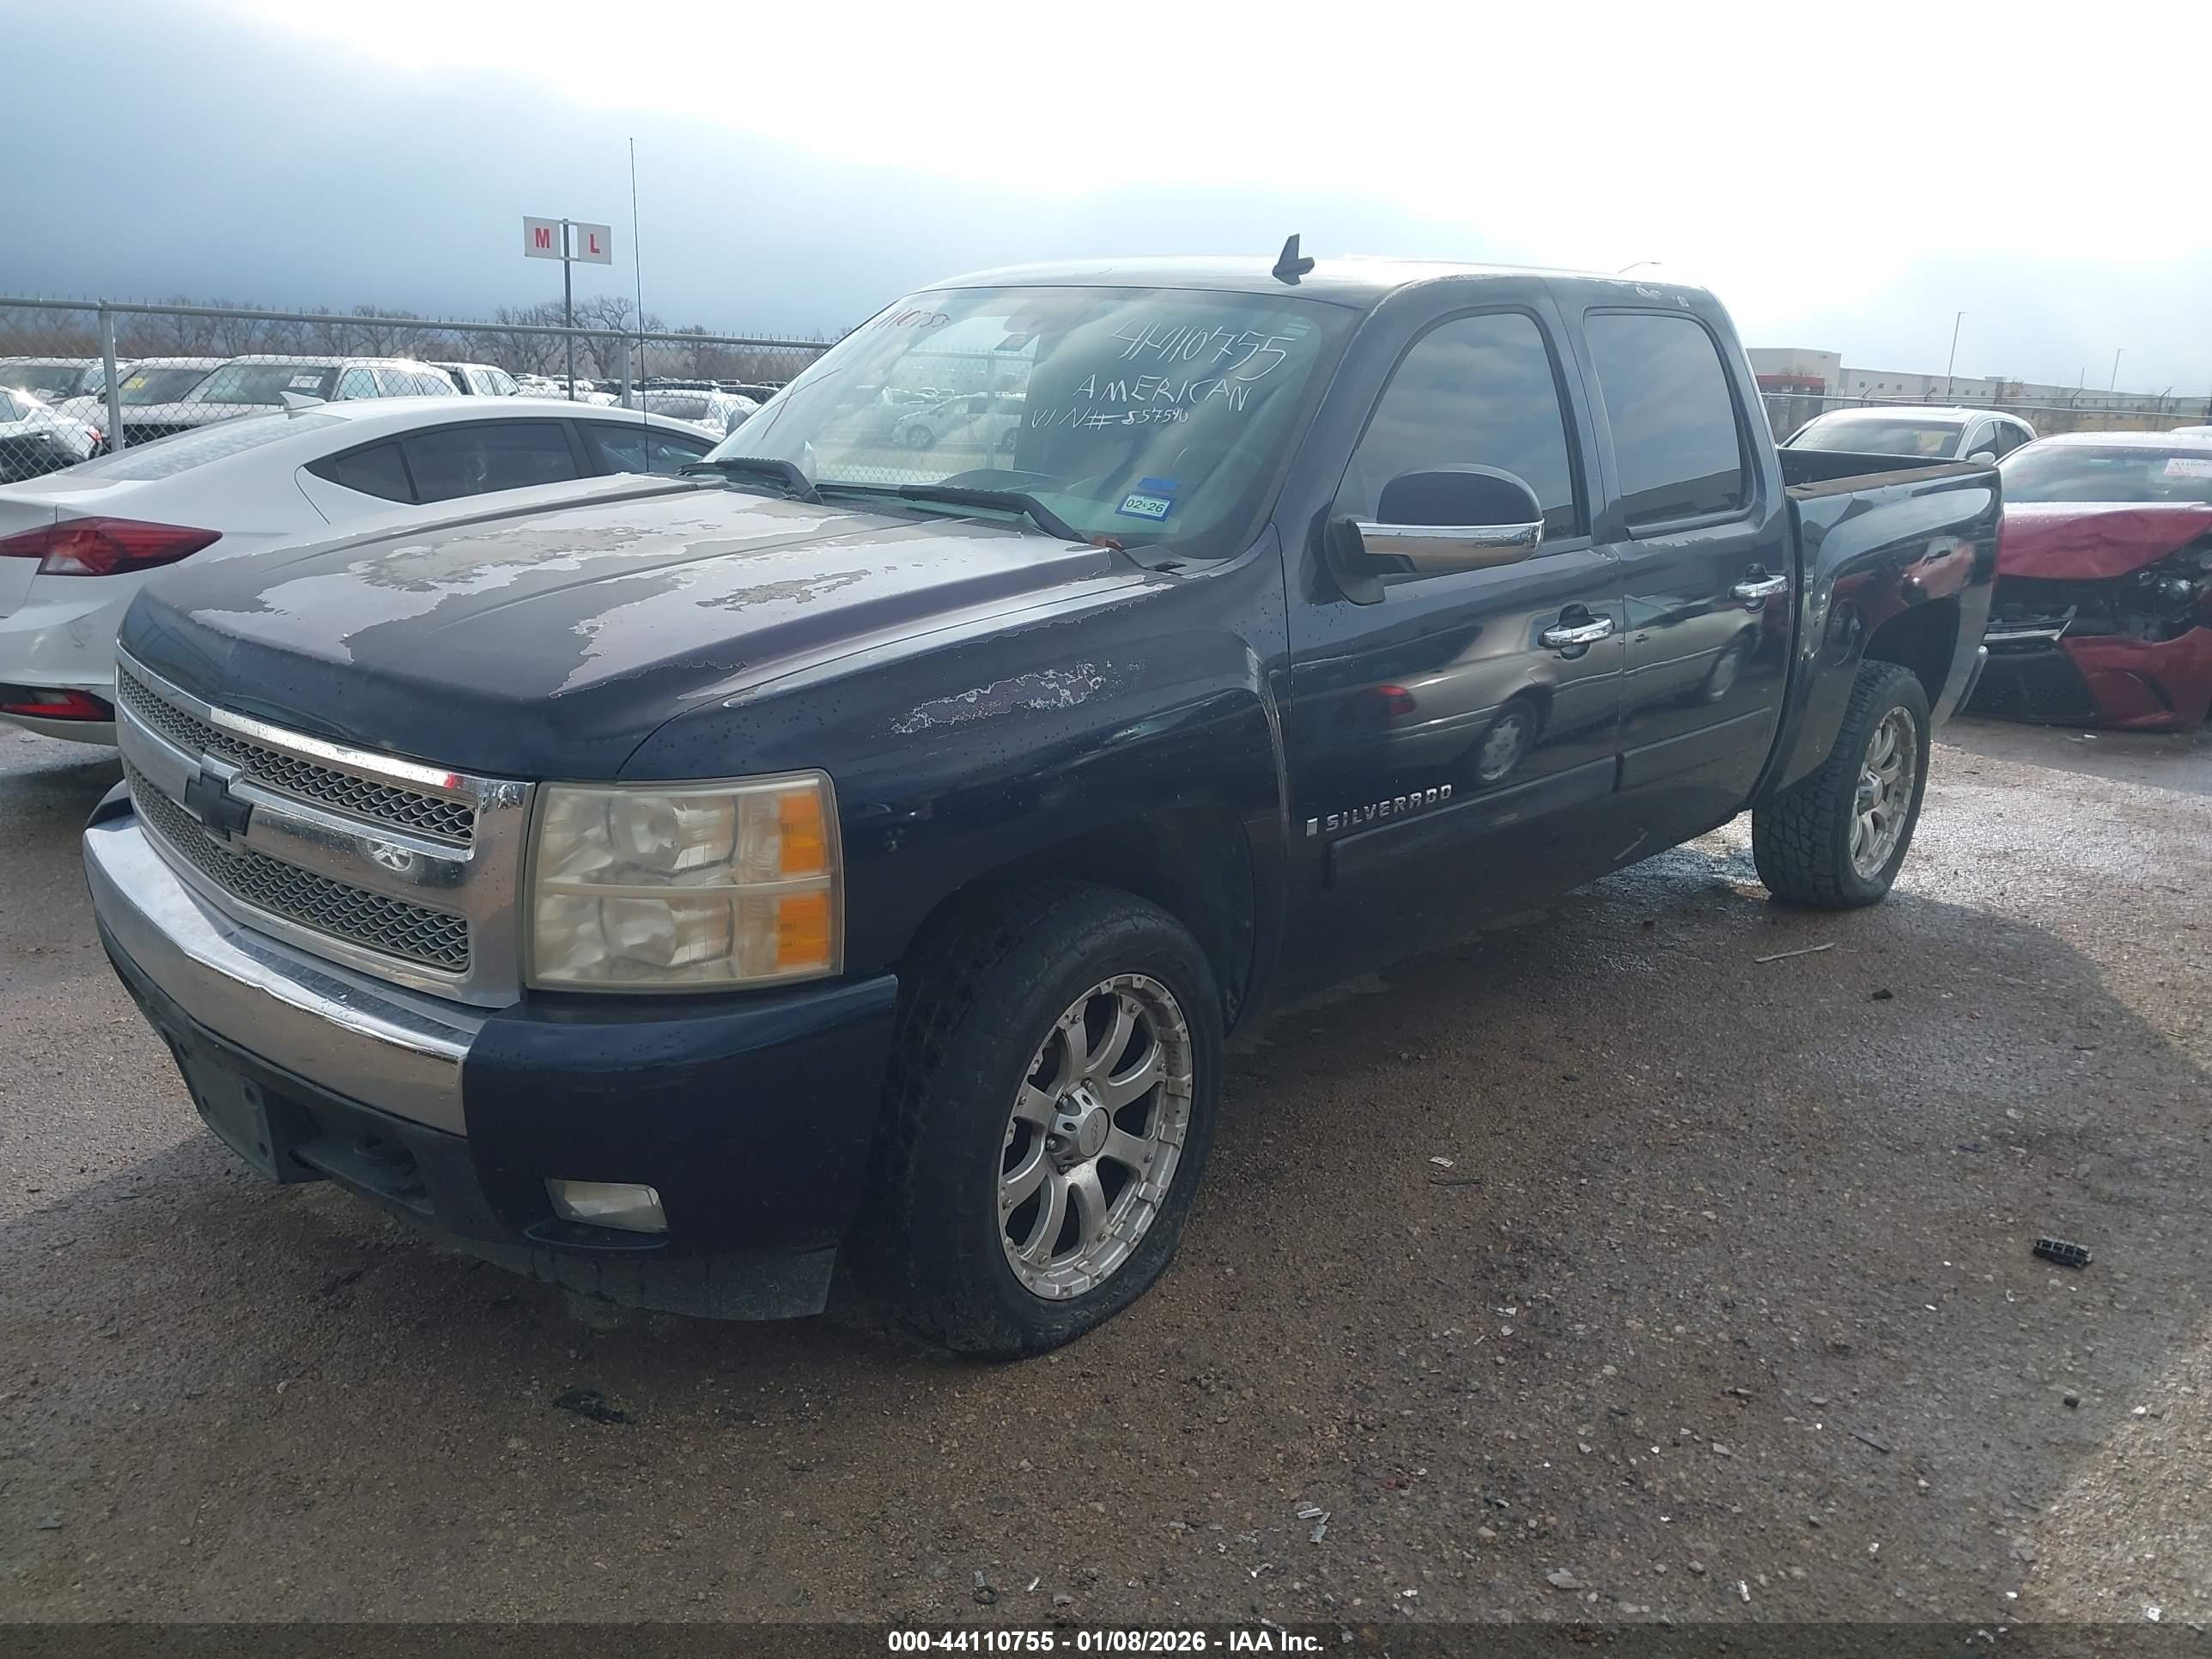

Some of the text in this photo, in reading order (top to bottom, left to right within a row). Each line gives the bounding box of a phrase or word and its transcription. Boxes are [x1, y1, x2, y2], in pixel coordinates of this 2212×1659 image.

[535, 228, 550, 248] M
[589, 233, 600, 253] L
[1112, 318, 1297, 381] 44110755
[1072, 374, 1252, 412] AMERICAN
[1325, 784, 1452, 832] SILVERADO
